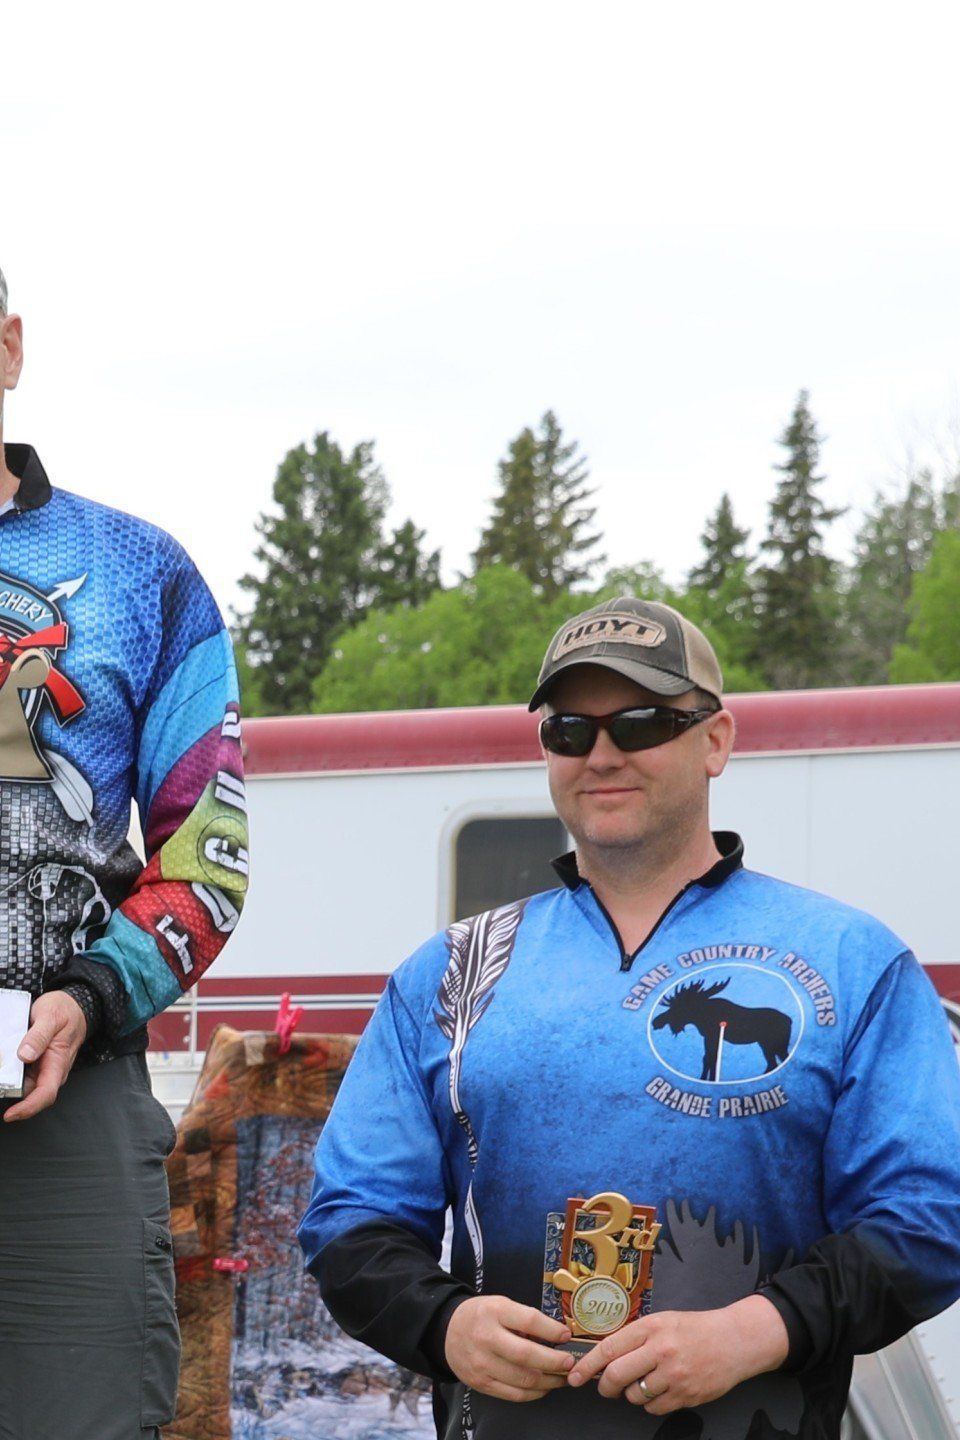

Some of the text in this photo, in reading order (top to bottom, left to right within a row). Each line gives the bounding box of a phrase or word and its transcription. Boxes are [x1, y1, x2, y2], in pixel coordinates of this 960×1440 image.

[563, 619, 648, 646] HOYT
[622, 944, 837, 1027] GAME COUNTRY ARCHERS
[646, 1076, 789, 1119] GRANDE PRAIRIE
[585, 1299, 624, 1317] 2019
